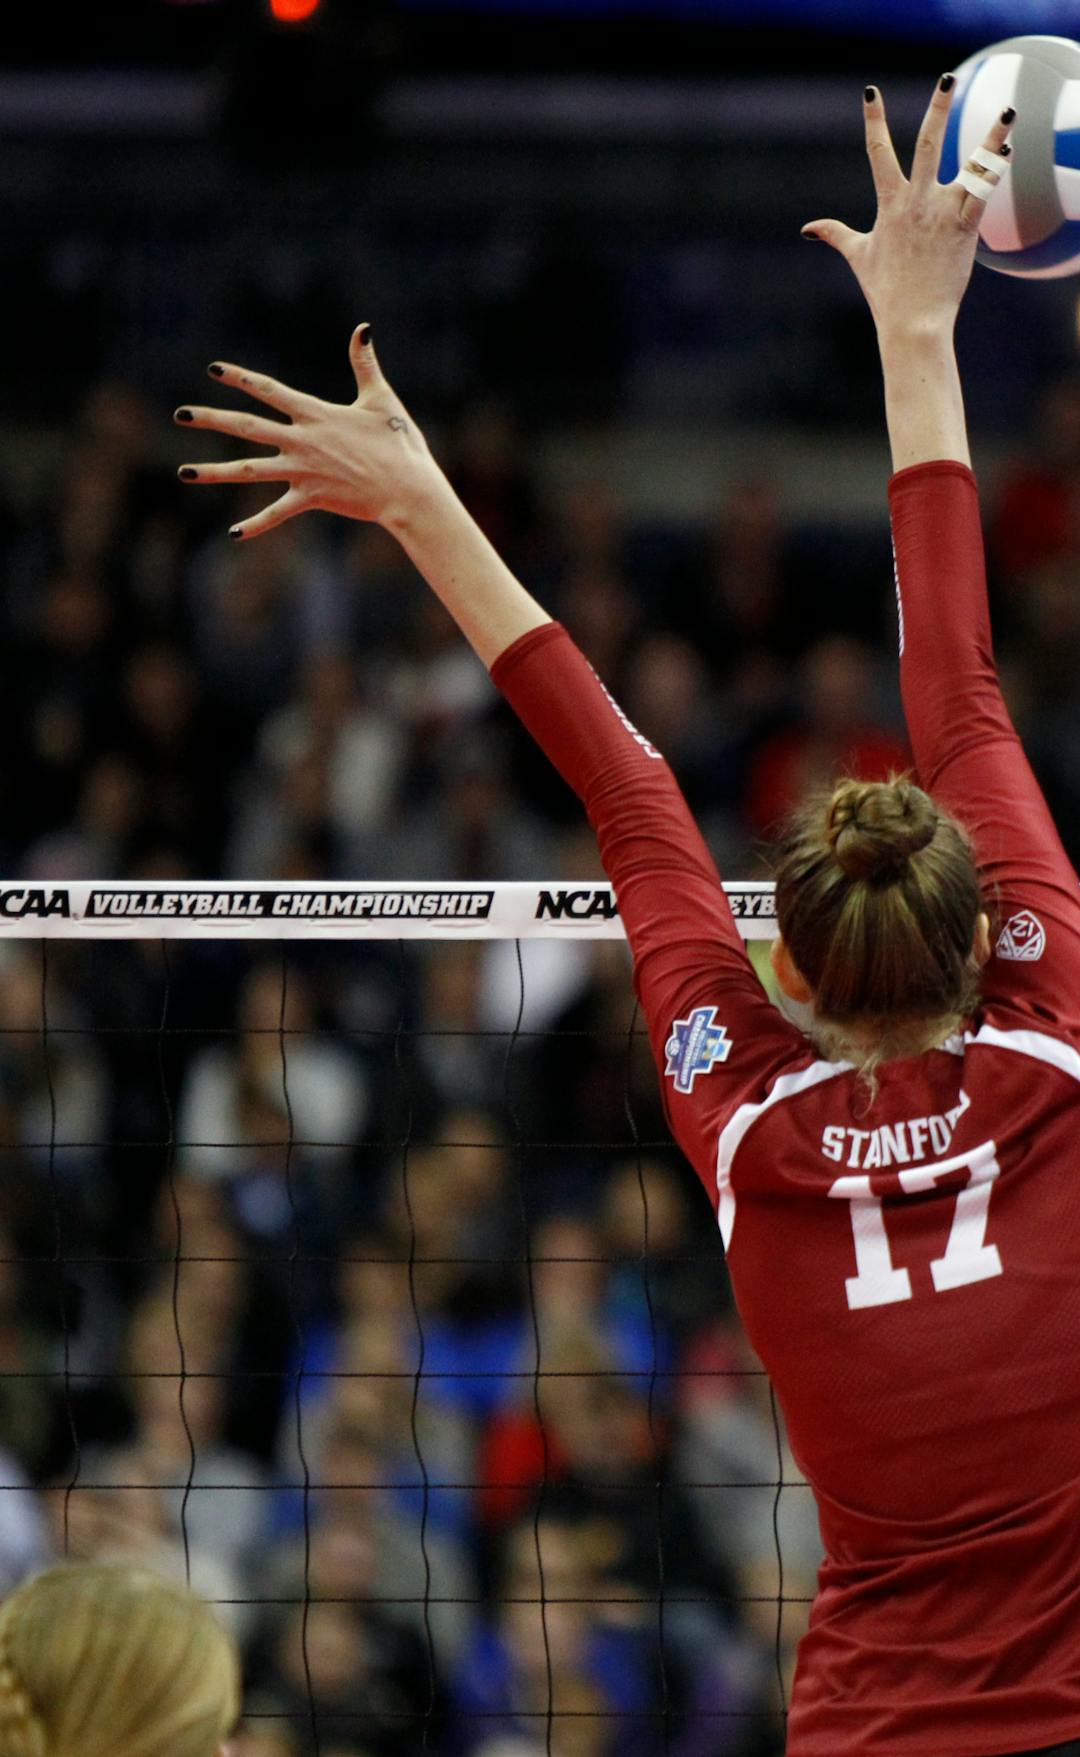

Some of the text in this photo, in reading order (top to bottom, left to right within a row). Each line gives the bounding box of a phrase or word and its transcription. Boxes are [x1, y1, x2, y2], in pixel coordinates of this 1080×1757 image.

[0, 890, 489, 918] CAA VOLLEYBALL CHAMPIONSHIP
[535, 891, 620, 919] NCA
[827, 1139, 1003, 1311] 17
